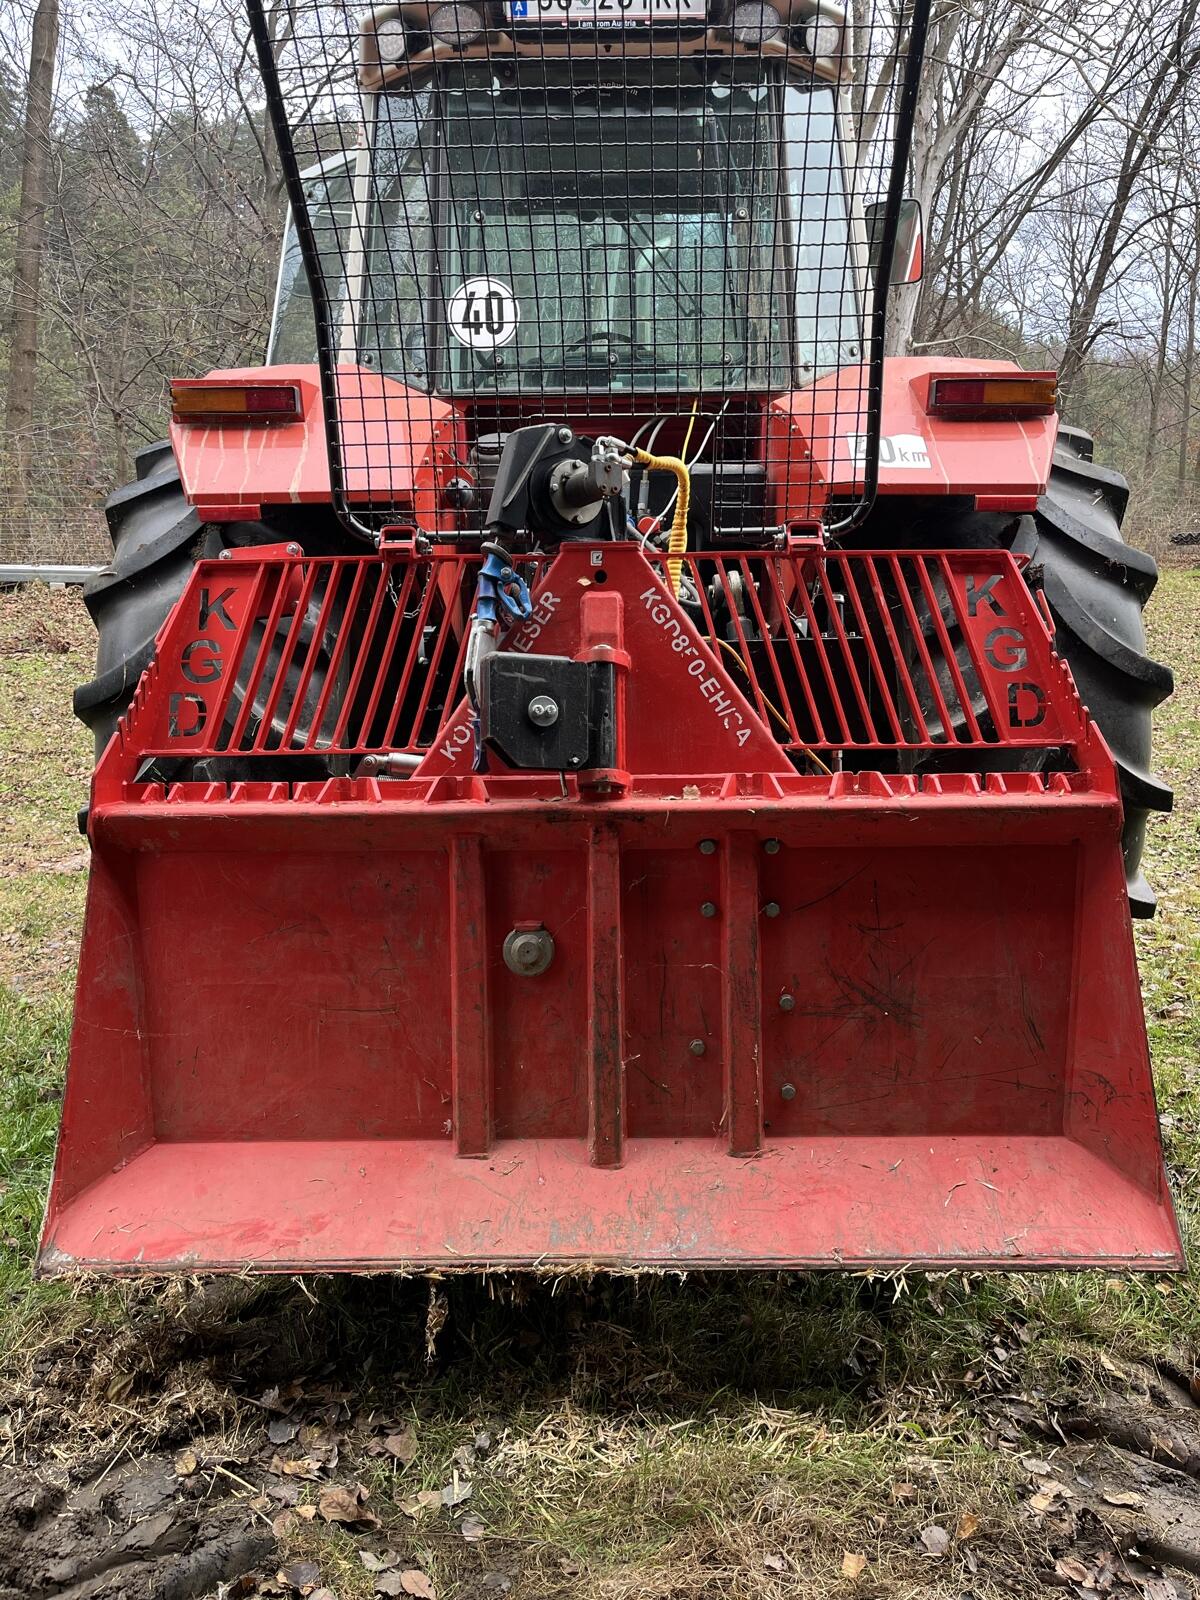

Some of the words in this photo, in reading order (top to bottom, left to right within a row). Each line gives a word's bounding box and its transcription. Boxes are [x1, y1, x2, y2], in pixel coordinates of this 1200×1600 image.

[515, 1, 524, 11] A
[612, 19, 637, 28] Autria
[461, 290, 505, 336] 40
[898, 447, 927, 463] km
